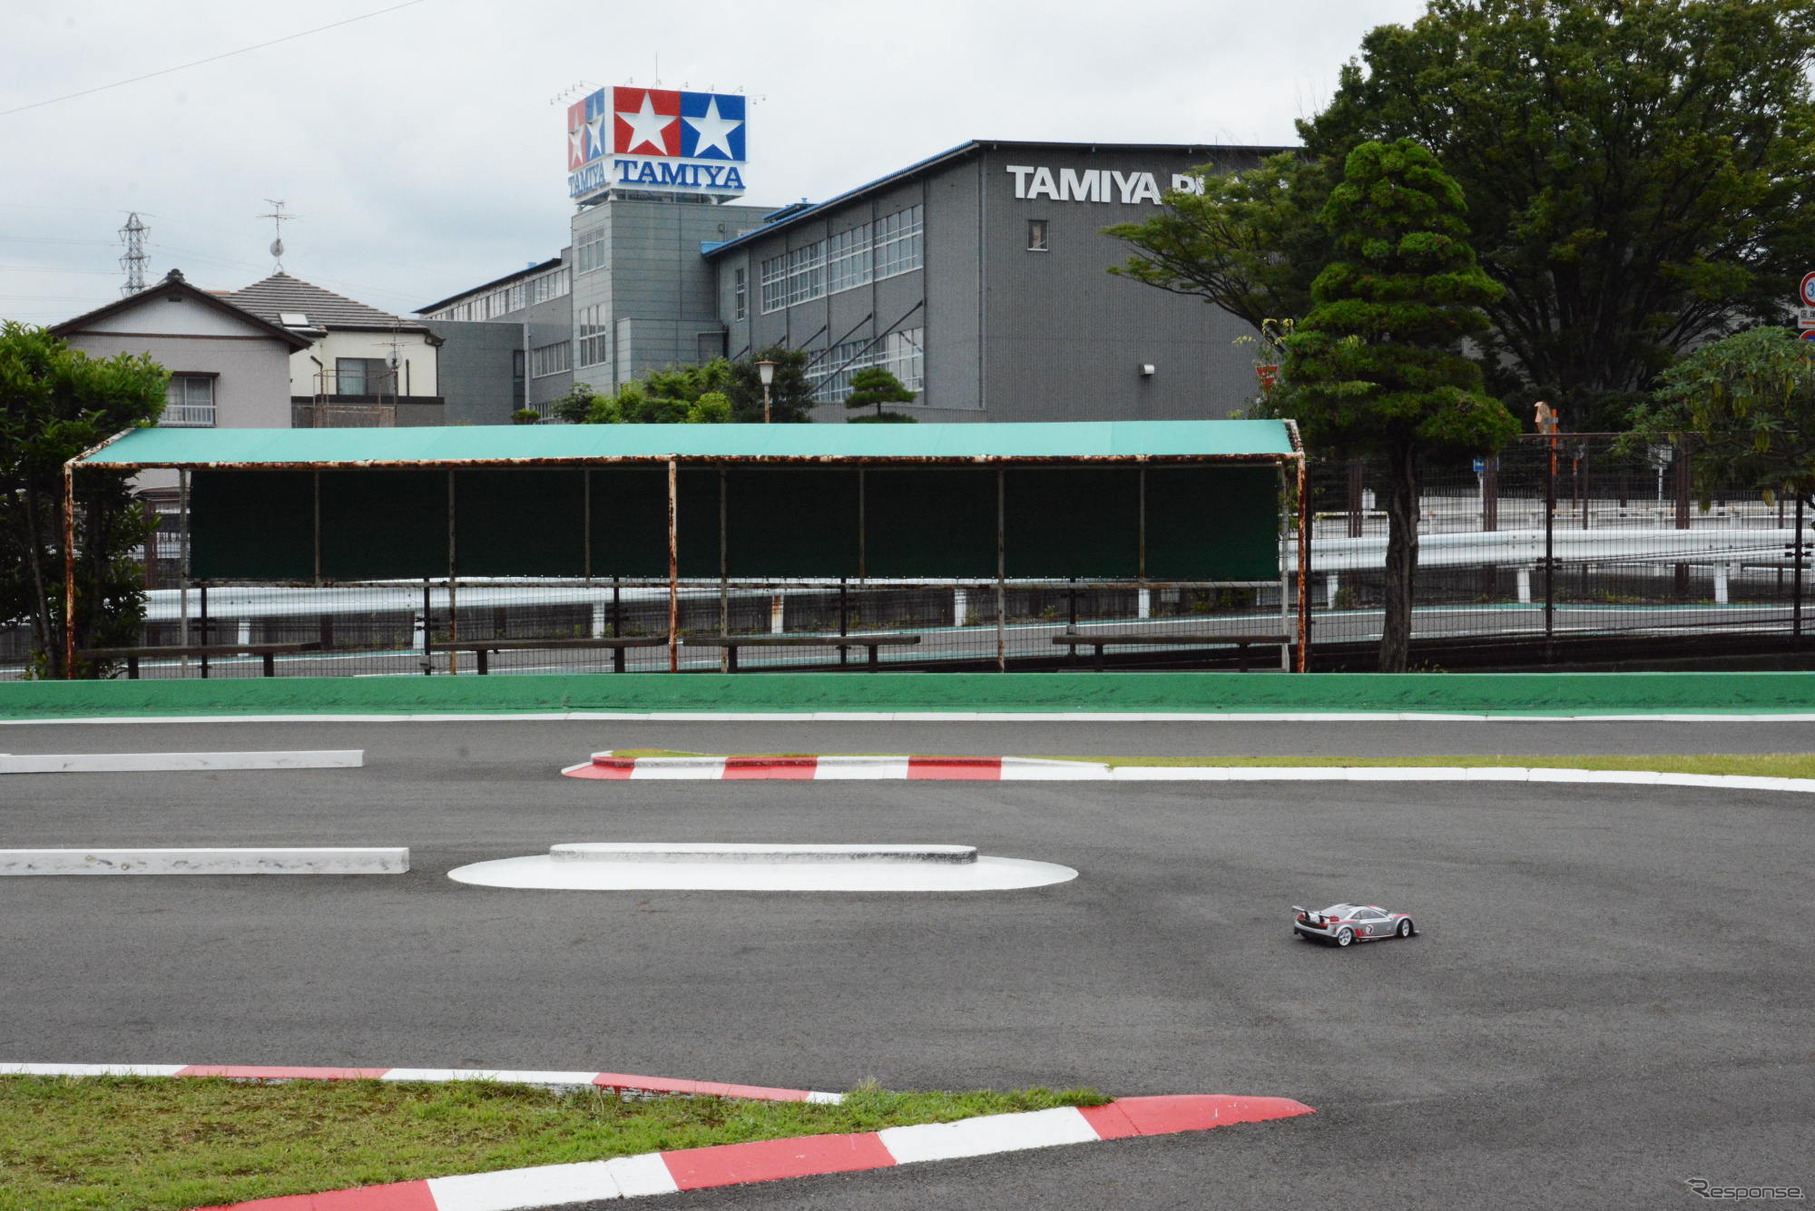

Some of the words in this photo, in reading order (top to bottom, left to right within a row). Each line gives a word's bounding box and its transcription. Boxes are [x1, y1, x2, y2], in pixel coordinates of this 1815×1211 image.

[568, 161, 606, 198] TAMIYA
[614, 159, 746, 190] TAMIYA
[1006, 165, 1163, 206] TAMIYA
